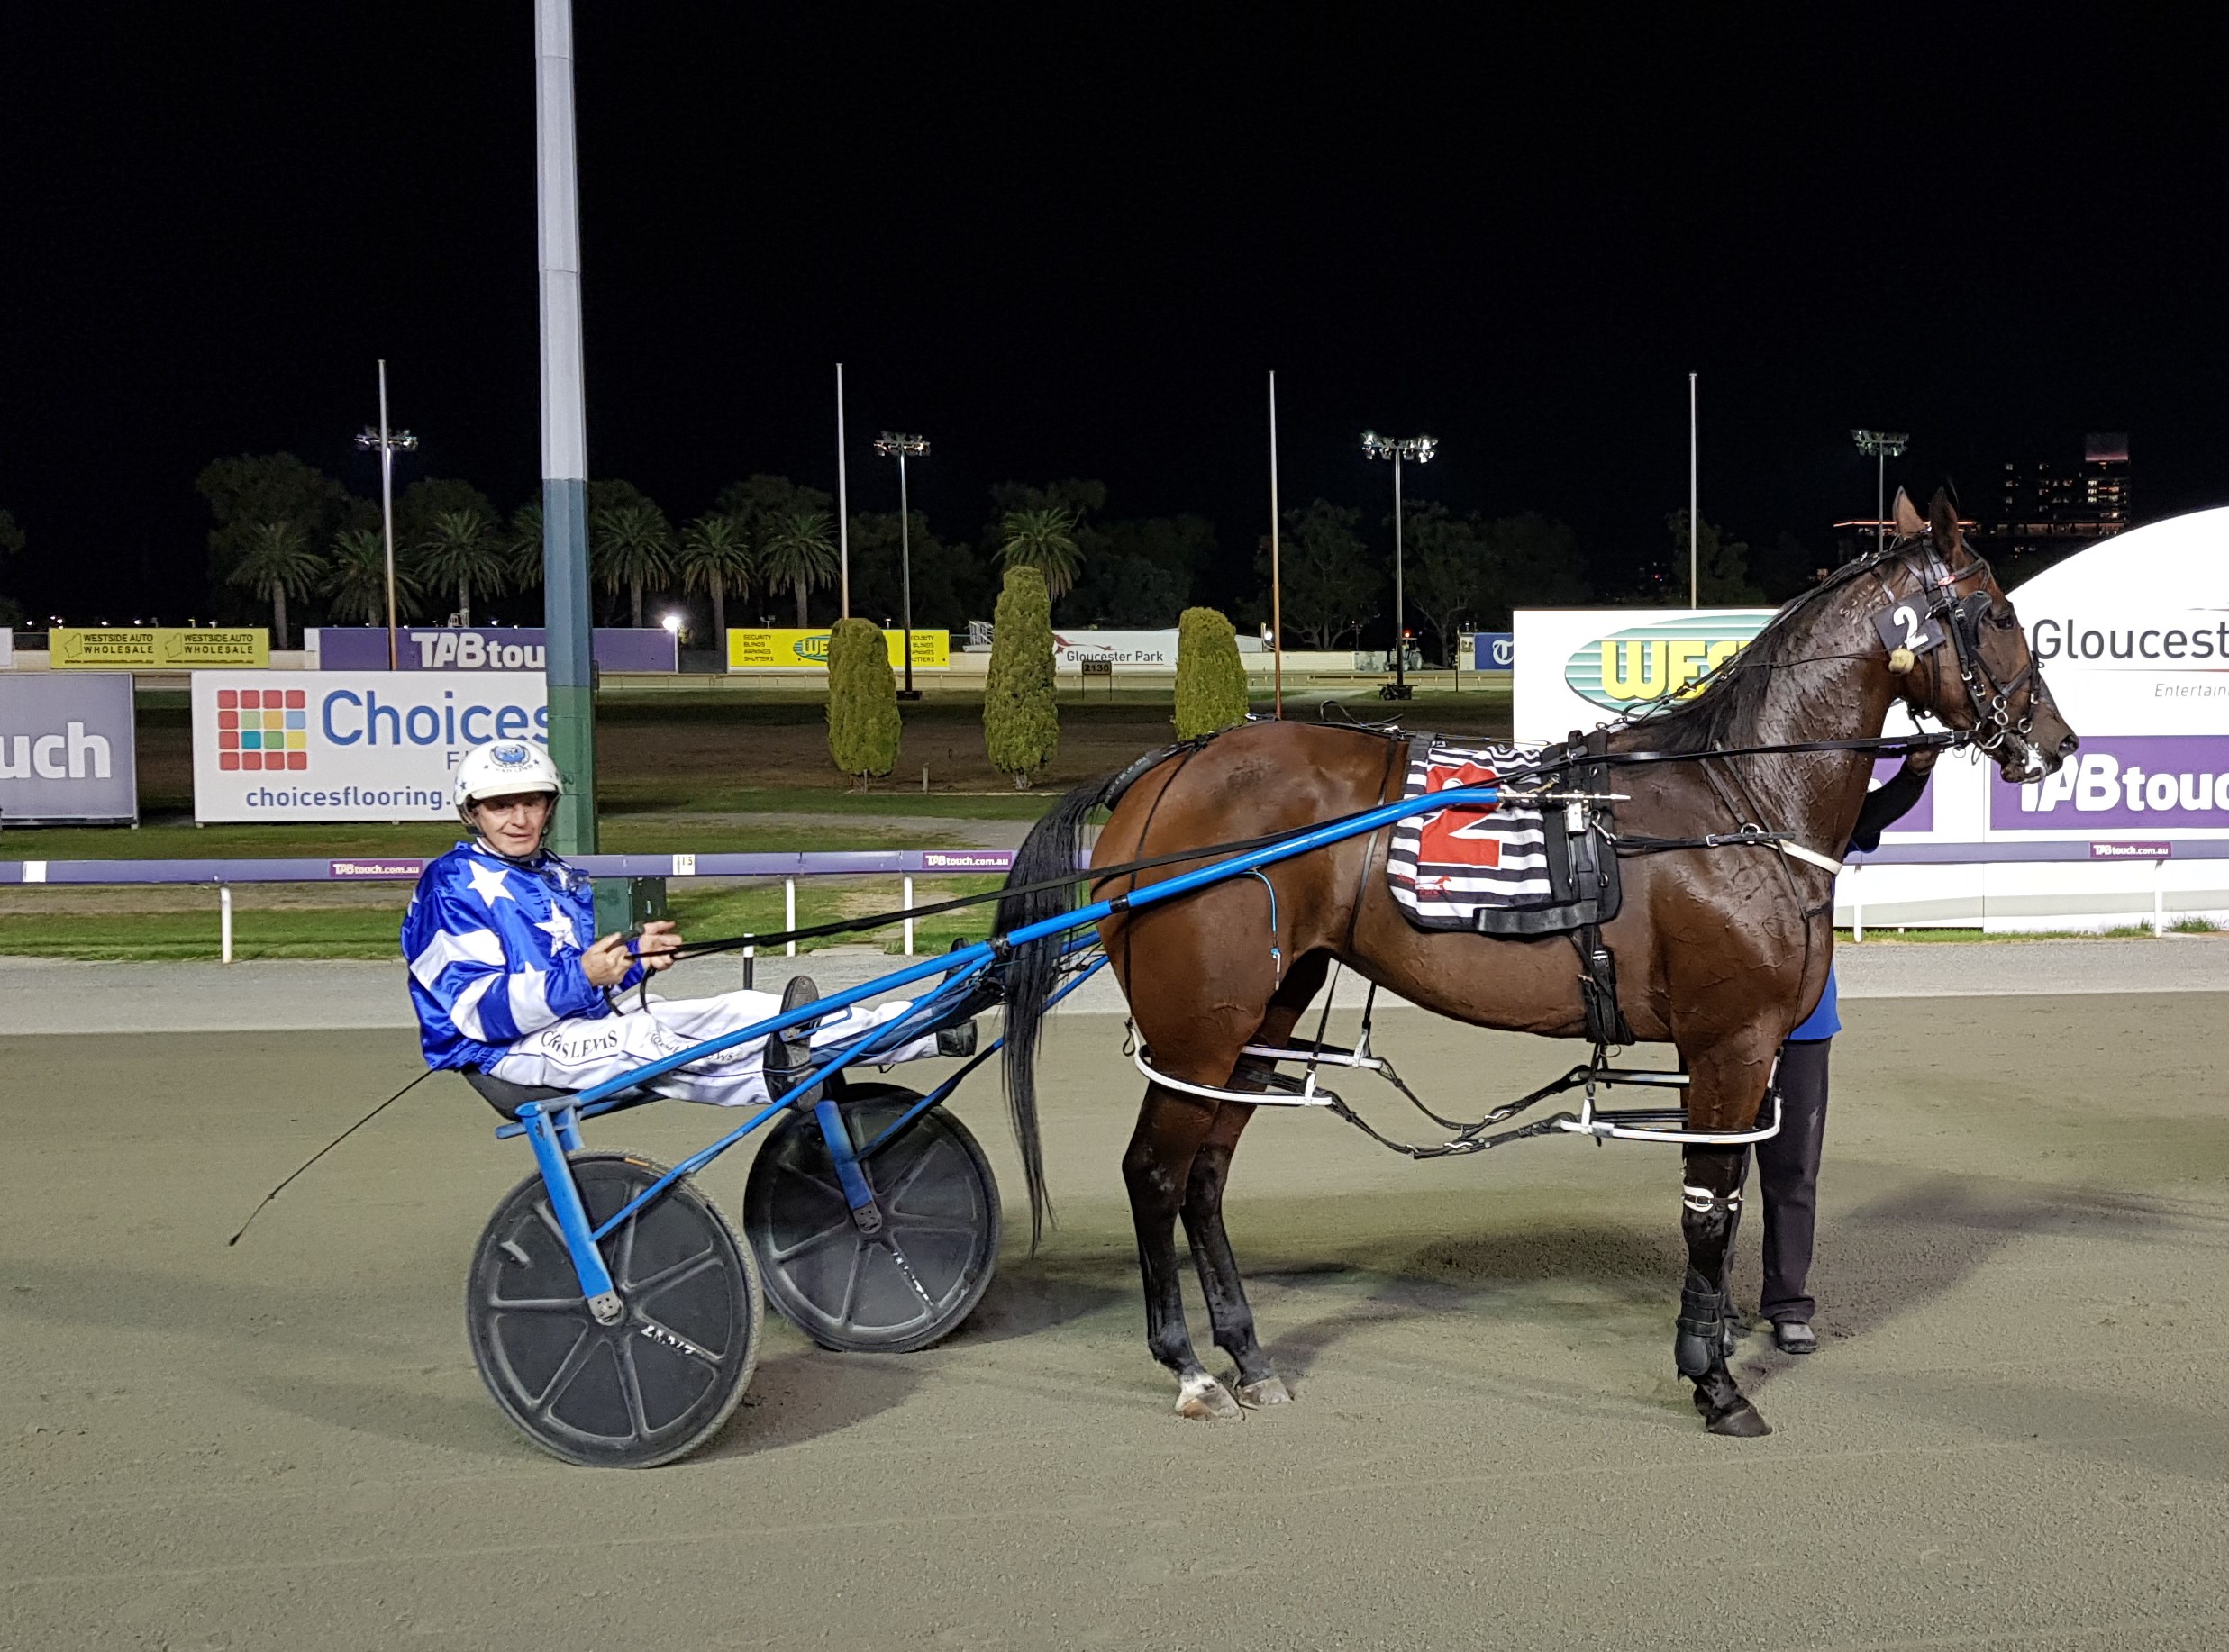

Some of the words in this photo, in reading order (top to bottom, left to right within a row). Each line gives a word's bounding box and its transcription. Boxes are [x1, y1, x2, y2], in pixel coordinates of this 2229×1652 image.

[1893, 605, 1929, 650] 2
[84, 634, 127, 642] WESTSIDE
[129, 634, 153, 642] AUTO
[184, 634, 226, 642] WESTSIDE
[230, 634, 253, 642] AUTO
[84, 645, 154, 654] WHOLESALE
[184, 645, 253, 654] WHOLESALE
[1067, 650, 1132, 662] Gloucester
[1135, 650, 1163, 662] Park
[1084, 664, 1109, 672] 2130
[2155, 683, 2229, 697] Entertain
[2093, 845, 2168, 855] TABtouch.com.au
[925, 855, 1008, 866] TABtouch.com.au
[333, 863, 419, 875] TABtouch.com.au
